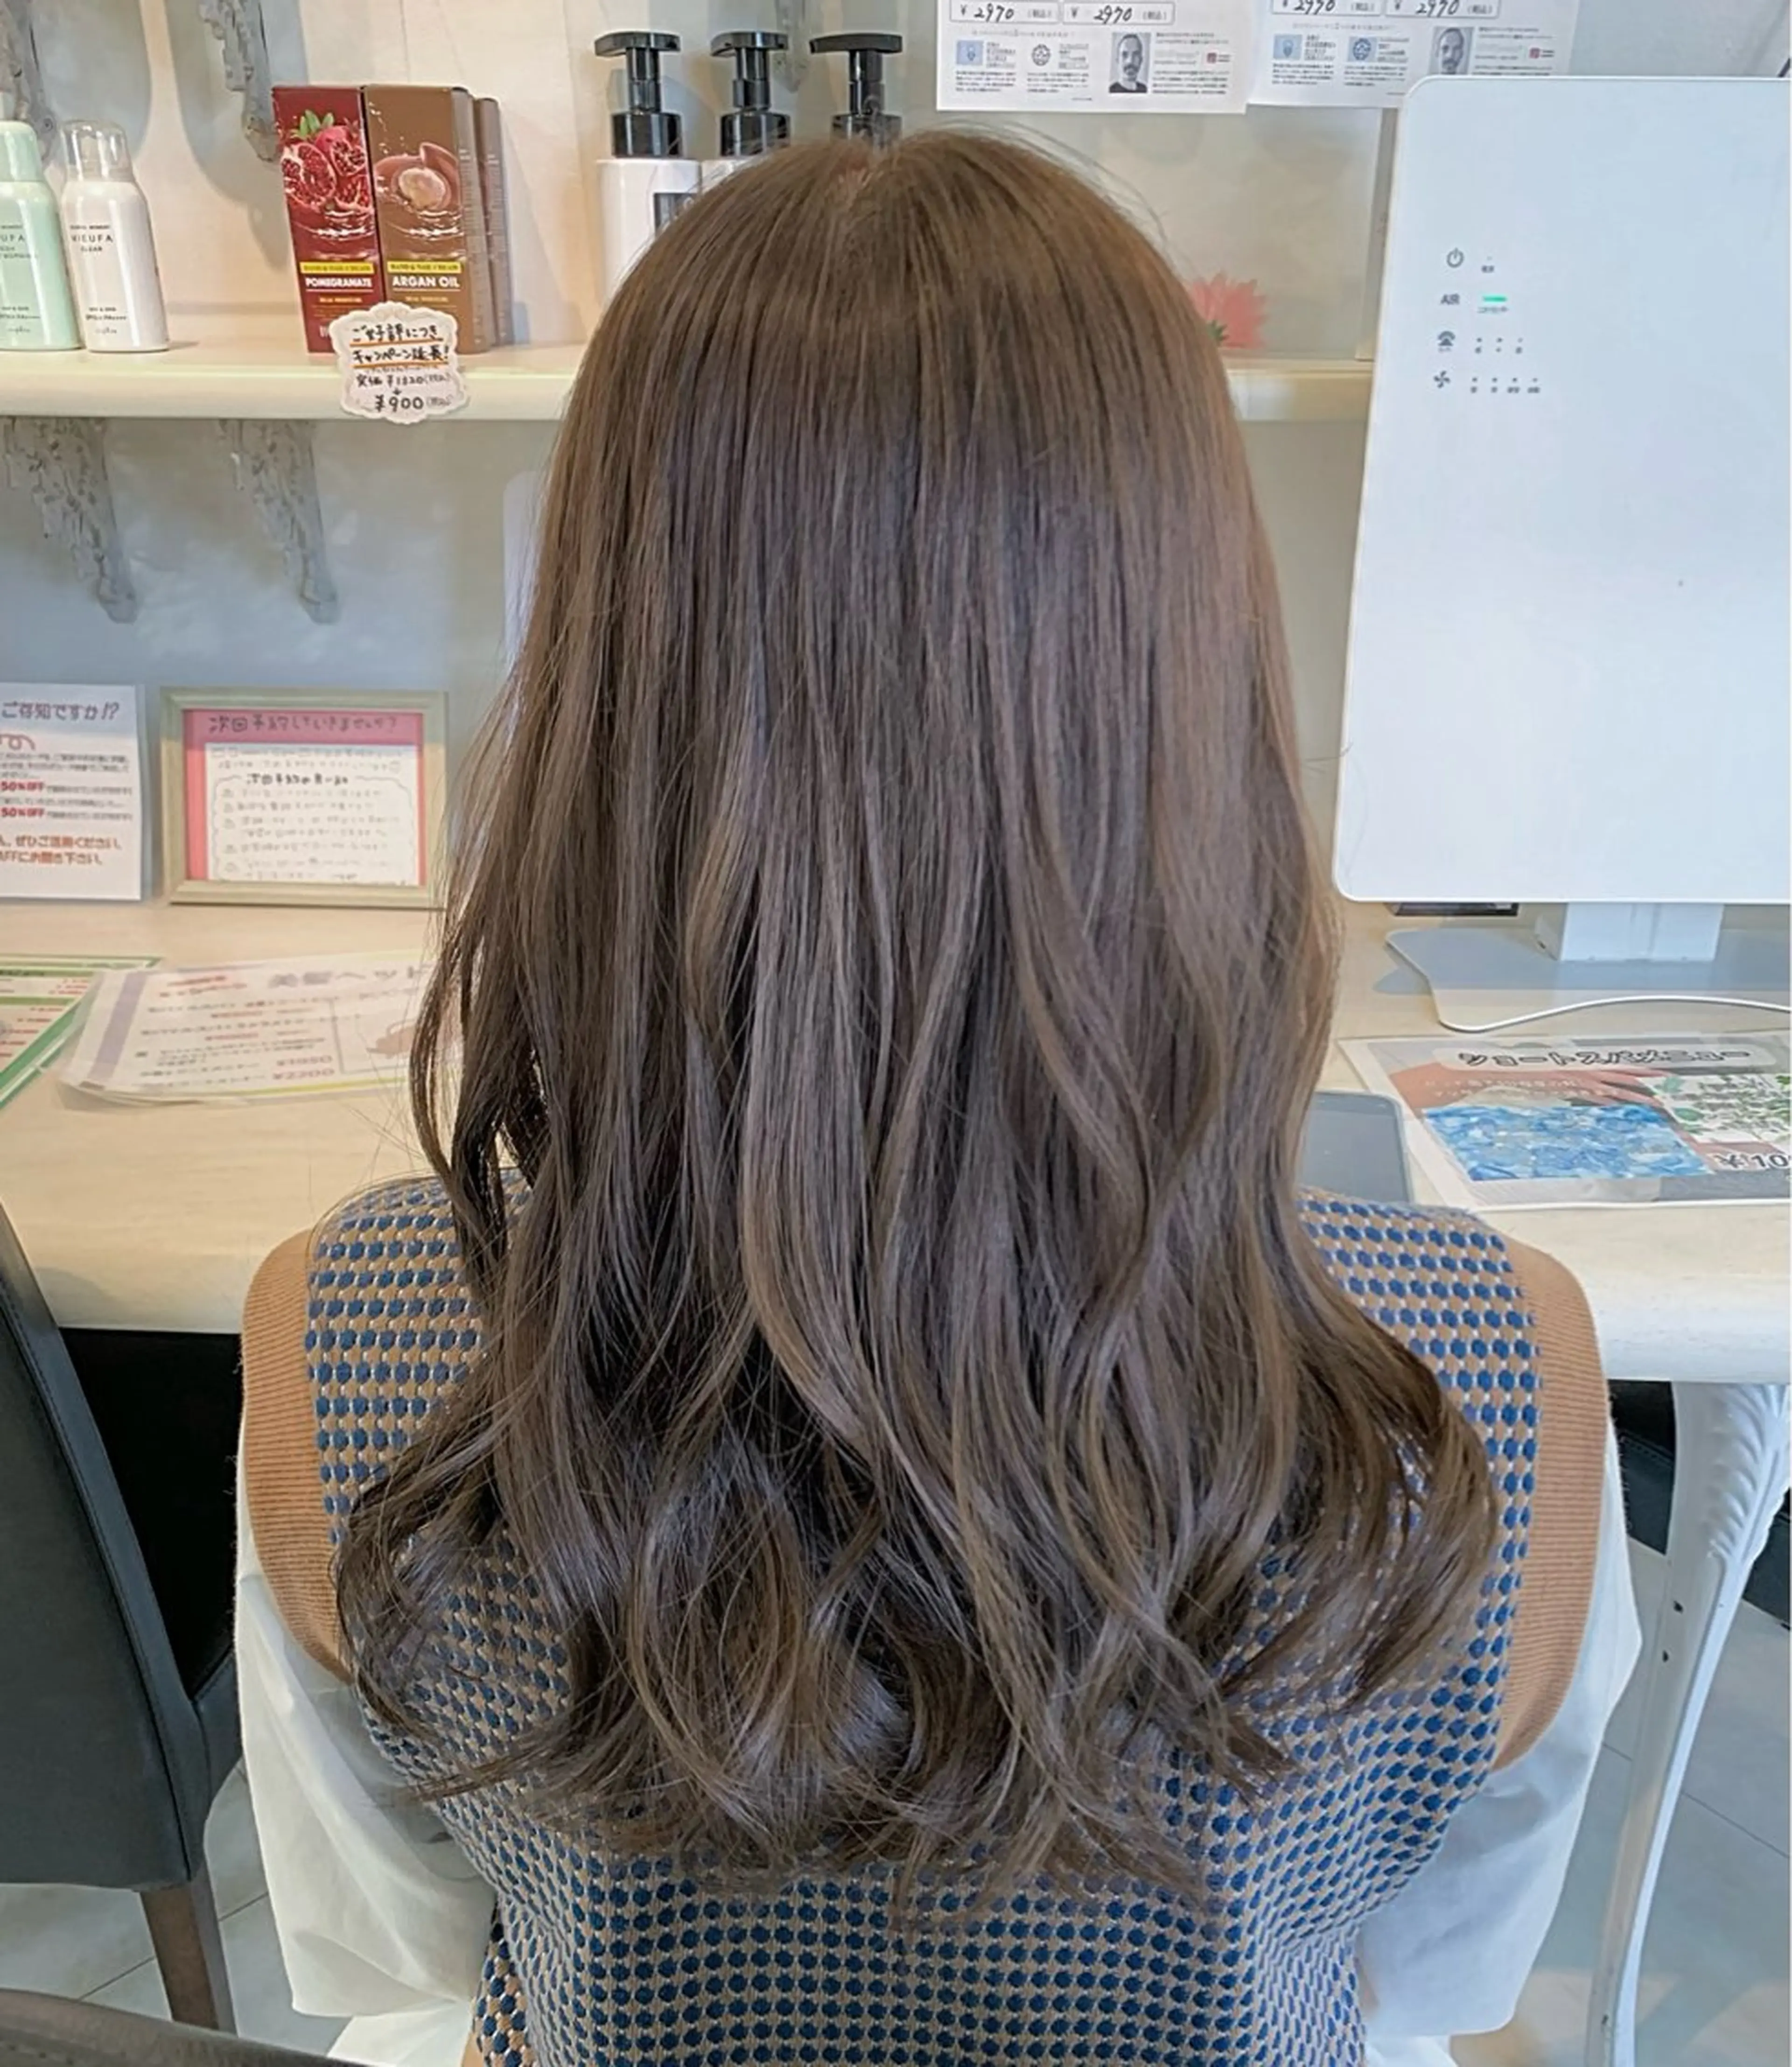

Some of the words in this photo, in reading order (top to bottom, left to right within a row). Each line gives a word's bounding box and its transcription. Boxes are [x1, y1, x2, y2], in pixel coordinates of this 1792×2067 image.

[973, 4, 1014, 22] 2970
[1093, 6, 1133, 24] 2970
[1294, 0, 1336, 14] 2970
[1415, 0, 1459, 18] 2970
[305, 278, 372, 287] POMEGRANATE
[392, 276, 436, 287] ARGAN
[438, 277, 461, 287] OIL
[352, 323, 444, 343] ご好評につき
[375, 395, 424, 412] ¥900
[1458, 1049, 1751, 1066] ショートスパメニュー
